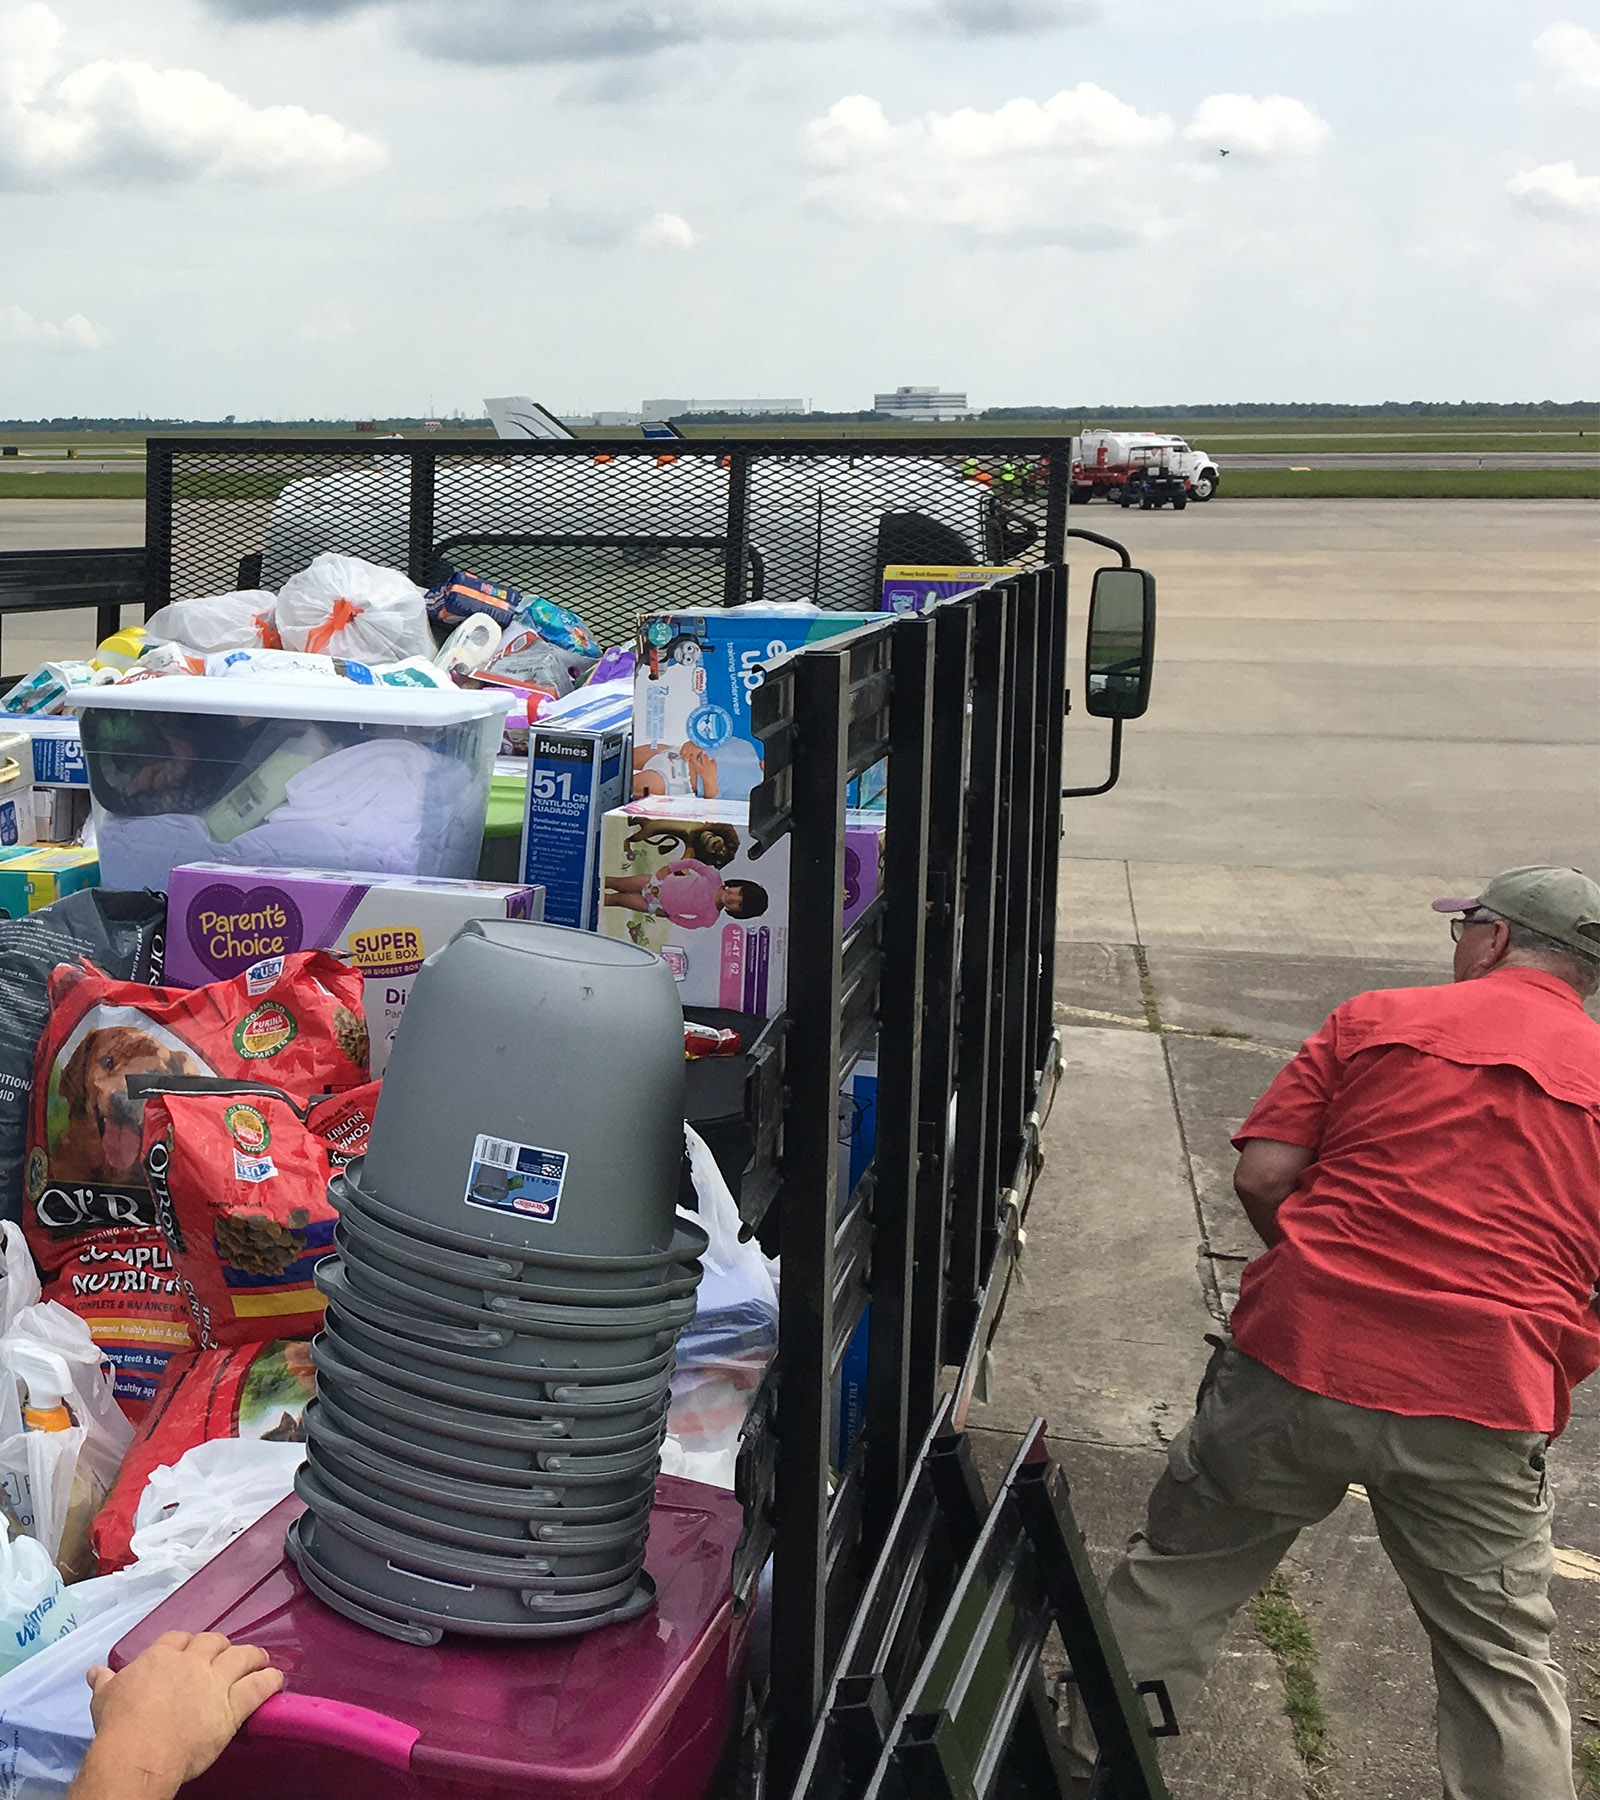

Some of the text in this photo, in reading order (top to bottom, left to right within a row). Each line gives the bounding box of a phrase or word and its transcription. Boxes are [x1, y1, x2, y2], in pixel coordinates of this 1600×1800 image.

[726, 641, 741, 716] training underwear
[659, 685, 669, 696] 72
[65, 741, 84, 770] 51
[540, 741, 588, 757] Holmes
[533, 769, 589, 804] 51 CM
[532, 797, 586, 811] VENTILADOR
[532, 805, 580, 817] CUADRADO
[199, 903, 287, 935] Parent's
[210, 935, 285, 960] Choice
[355, 932, 417, 953] SUPER
[357, 948, 419, 963] VALUE BOX
[731, 929, 741, 975] 3T-4T 62
[260, 963, 280, 978] USA
[373, 966, 403, 975] BIGGEST
[386, 987, 408, 1006] Di
[252, 1016, 283, 1029] PURINA
[239, 1047, 275, 1058] COMPARE
[277, 1039, 288, 1049] TO
[326, 1111, 367, 1141] NUTRIT
[77, 1300, 175, 1312] COMPLETE & BALANCED
[91, 1326, 118, 1335] promote
[120, 1325, 146, 1337] healthy
[149, 1327, 163, 1337] skin
[165, 1328, 172, 1337] &
[124, 1353, 151, 1364] teeth &
[113, 1382, 141, 1396] healthy
[849, 1381, 858, 1398] TILT
